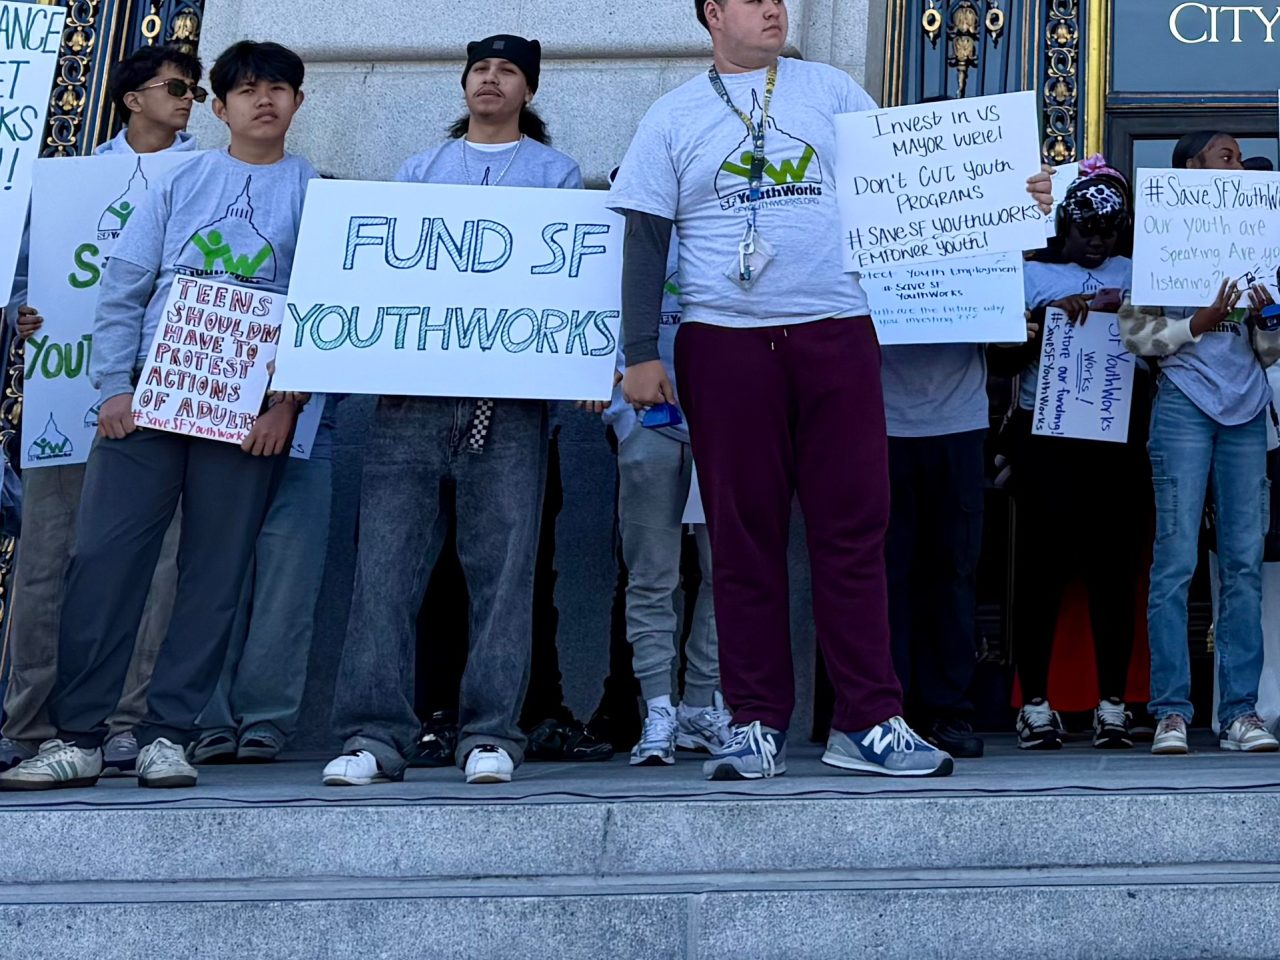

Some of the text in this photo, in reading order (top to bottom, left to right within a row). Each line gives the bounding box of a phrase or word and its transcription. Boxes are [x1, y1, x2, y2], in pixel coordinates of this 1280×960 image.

[866, 110, 943, 139] Invest
[892, 134, 947, 158] MAYOR
[853, 171, 908, 196] Don't
[896, 184, 985, 215] PROGRAMS
[1143, 214, 1171, 234] Our
[1239, 221, 1267, 237] are
[342, 216, 611, 278] FUND SF
[1228, 242, 1256, 262] Are
[177, 277, 273, 317] TEENS
[163, 323, 259, 362] HAVE TO
[287, 302, 620, 357] YOUTHWORKS
[155, 342, 255, 380] PROTEST
[139, 388, 170, 411] OF
[146, 365, 242, 403] ACTIONS
